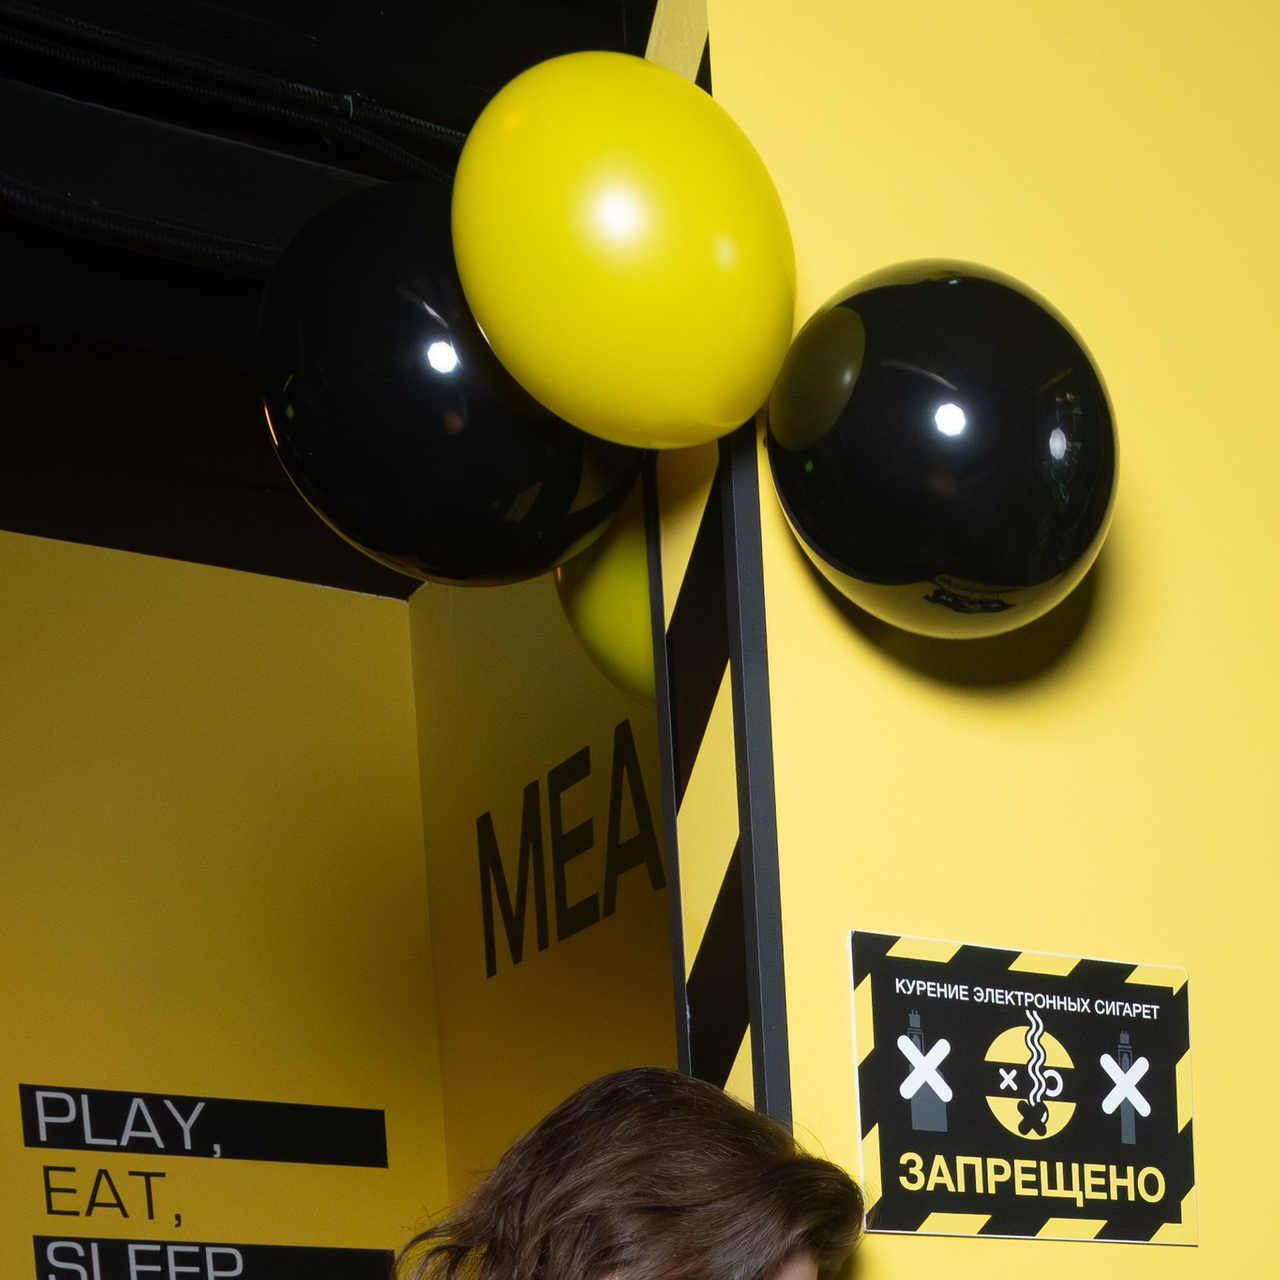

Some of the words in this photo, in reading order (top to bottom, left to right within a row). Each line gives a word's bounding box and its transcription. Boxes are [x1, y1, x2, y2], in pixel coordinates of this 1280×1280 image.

[895, 978, 969, 1001] КУРЕНИЕ
[973, 987, 1091, 1013] ЭЛЕКТРОННЫХ
[1094, 1000, 1160, 1019] СИГАРЕТ
[35, 1090, 222, 1158] PLAY,
[43, 1165, 182, 1227] EAT,
[899, 1152, 1166, 1207] ЗАПРЕЩЕНО
